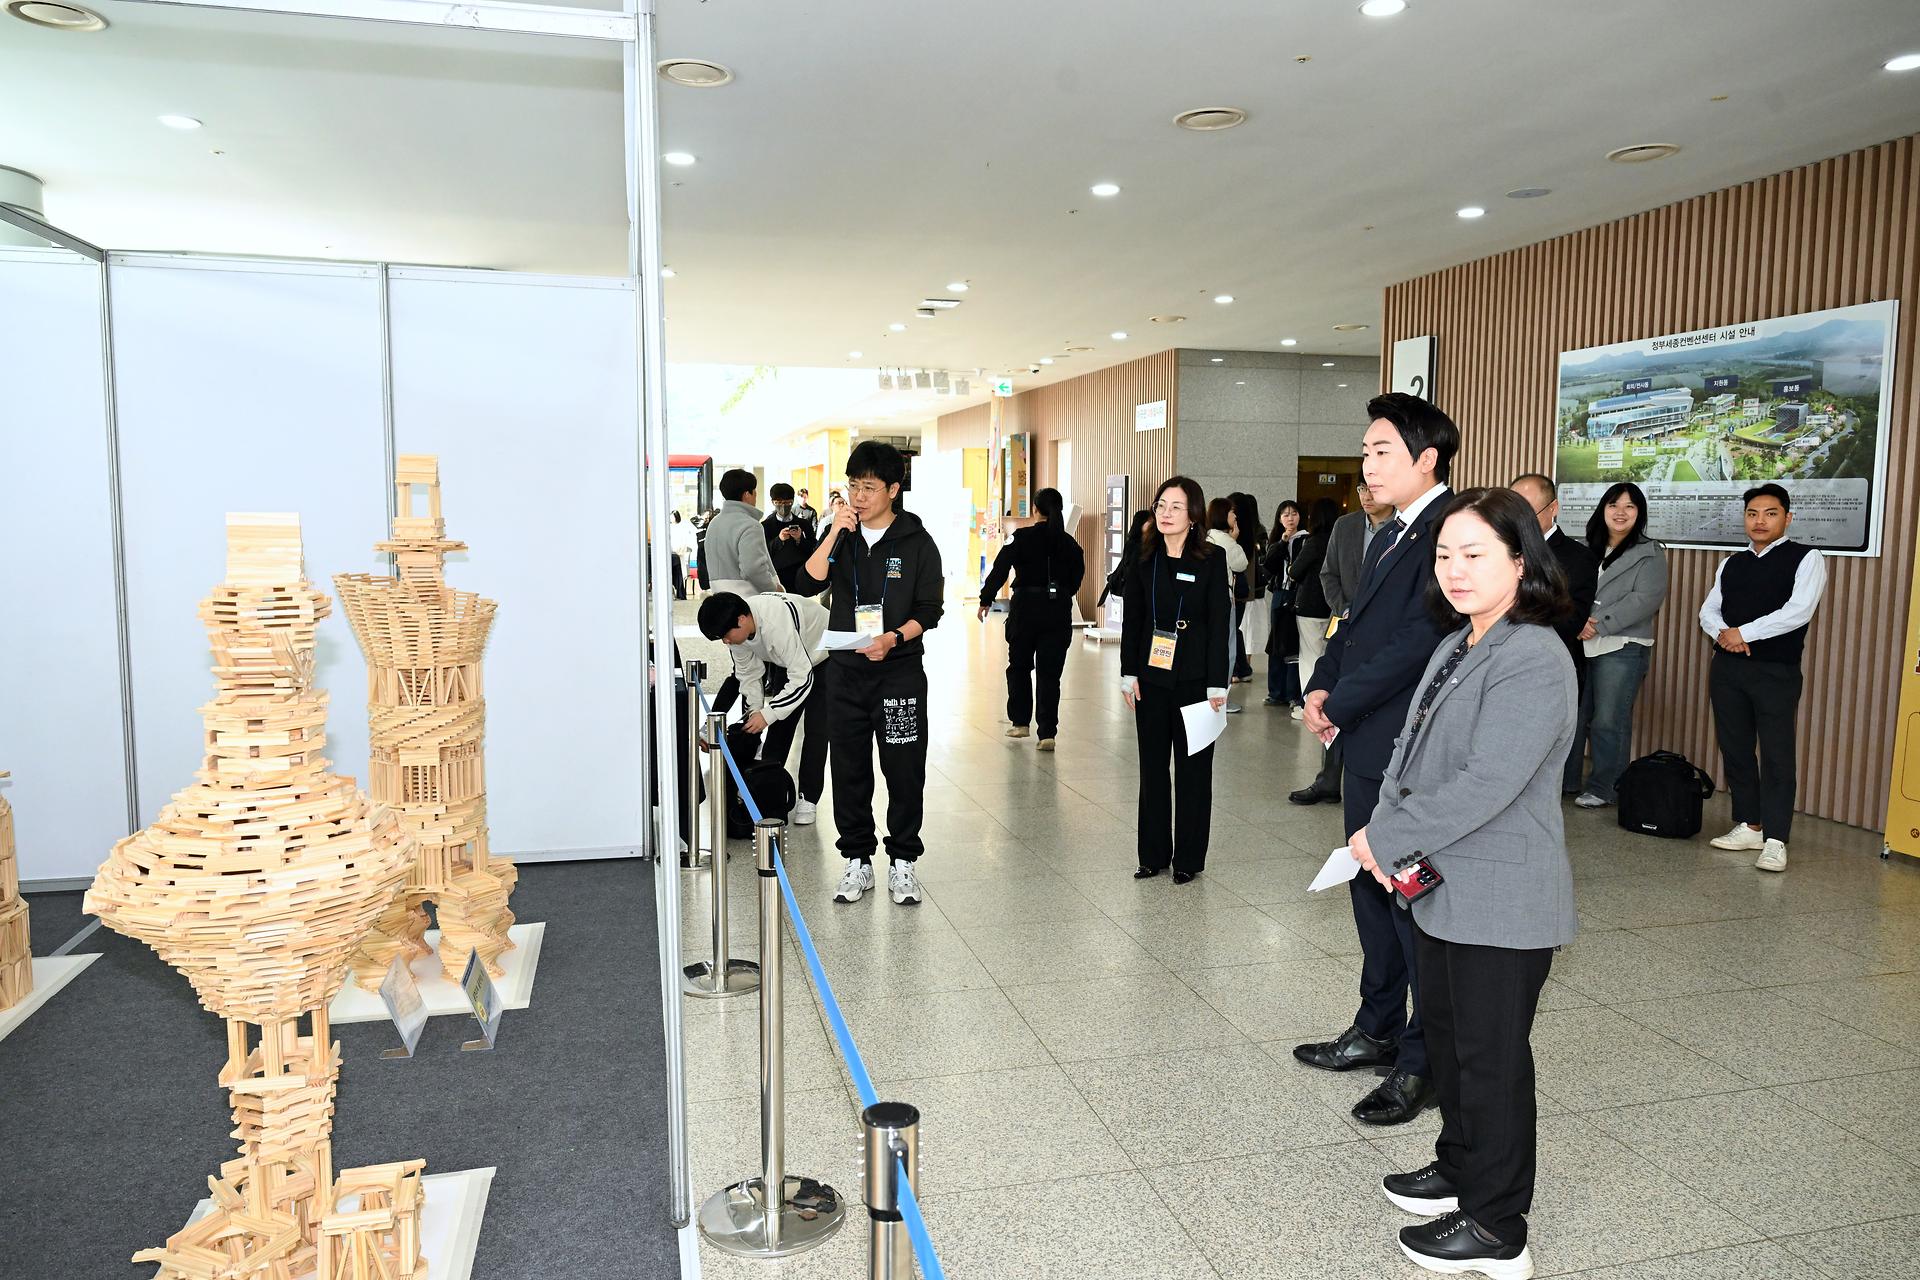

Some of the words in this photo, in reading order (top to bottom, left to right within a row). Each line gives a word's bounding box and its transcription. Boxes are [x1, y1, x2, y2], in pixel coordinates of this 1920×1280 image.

[1652, 332, 1717, 350] 정부세종컨벤션센터
[1720, 329, 1736, 340] 시설
[1739, 326, 1756, 337] 안내
[1783, 384, 1800, 393] 홍보동
[883, 698, 898, 706] Math
[900, 698, 906, 706] is
[907, 697, 917, 706] my
[885, 735, 918, 744] Superpower
